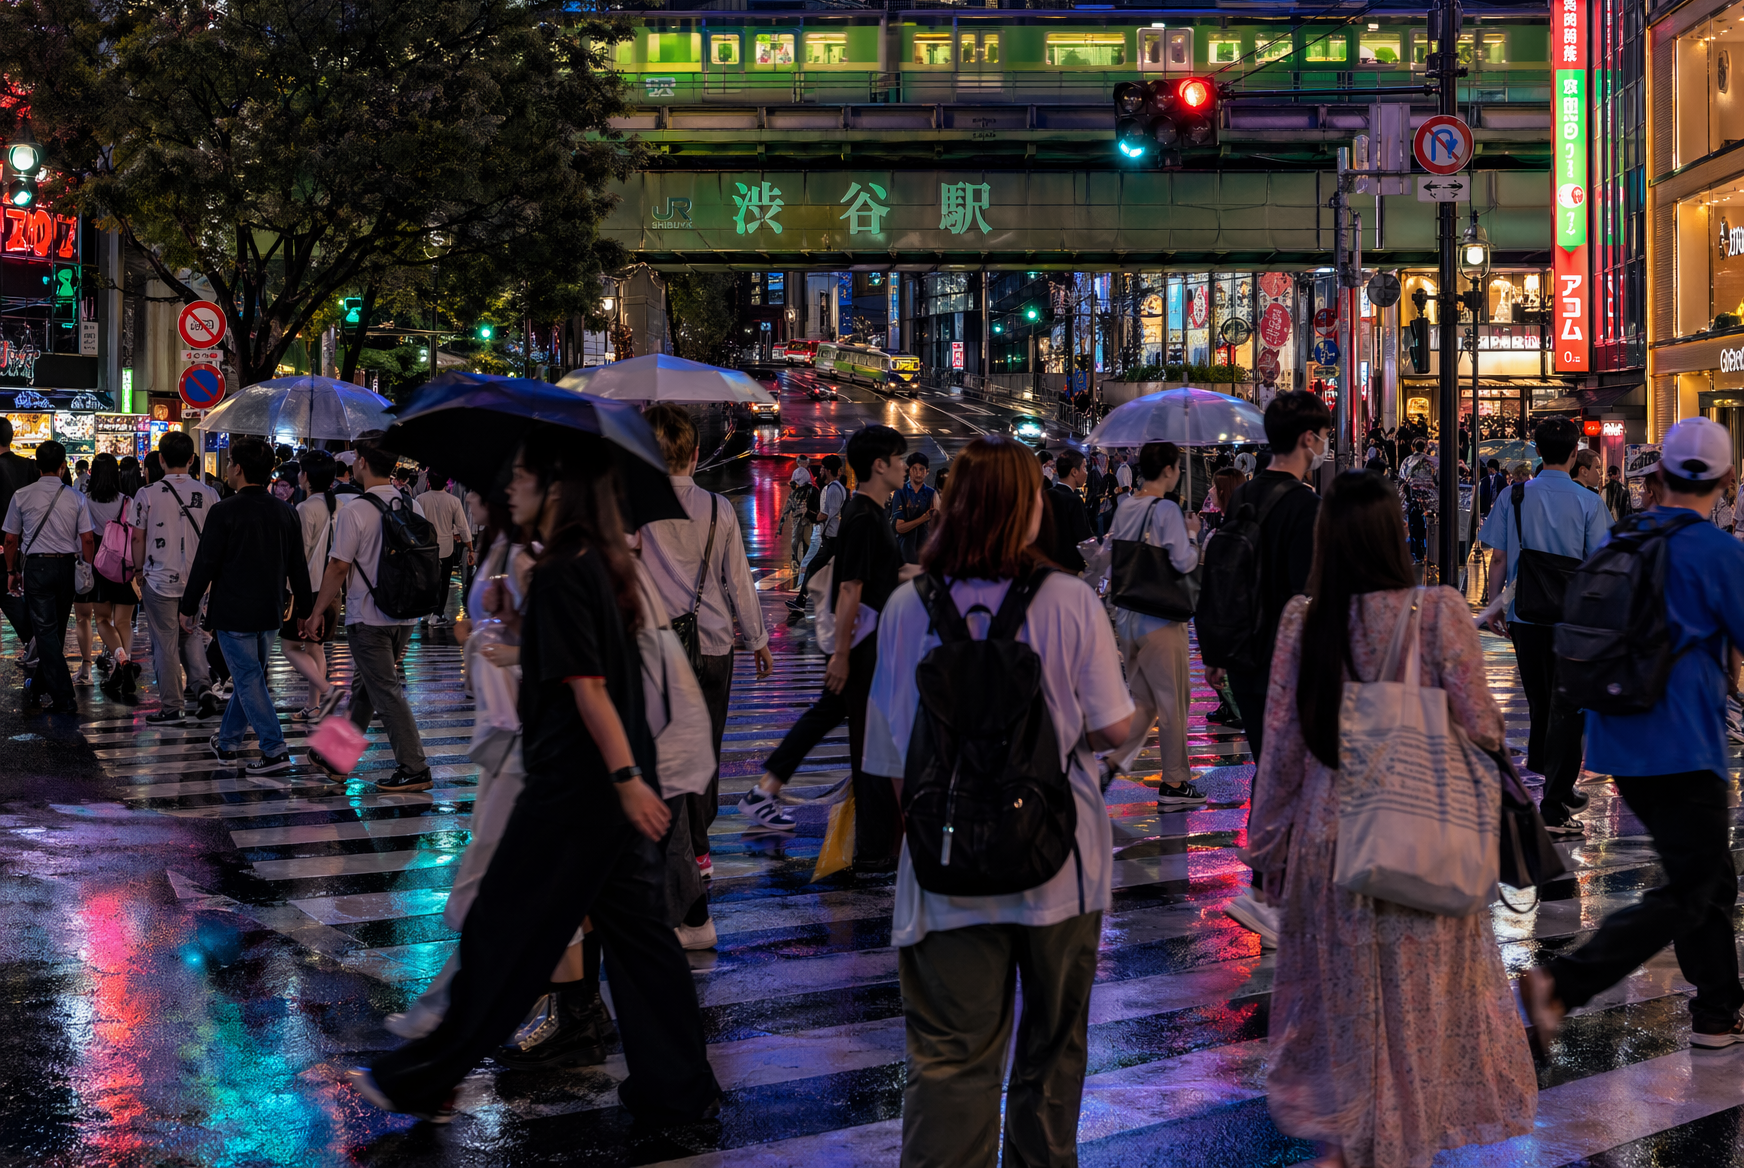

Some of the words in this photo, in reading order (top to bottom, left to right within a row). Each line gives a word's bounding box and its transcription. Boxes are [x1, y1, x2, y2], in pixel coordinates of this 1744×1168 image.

[651, 196, 692, 221] JR
[731, 181, 994, 236] 渋谷駅
[1561, 275, 1583, 341] アコム
